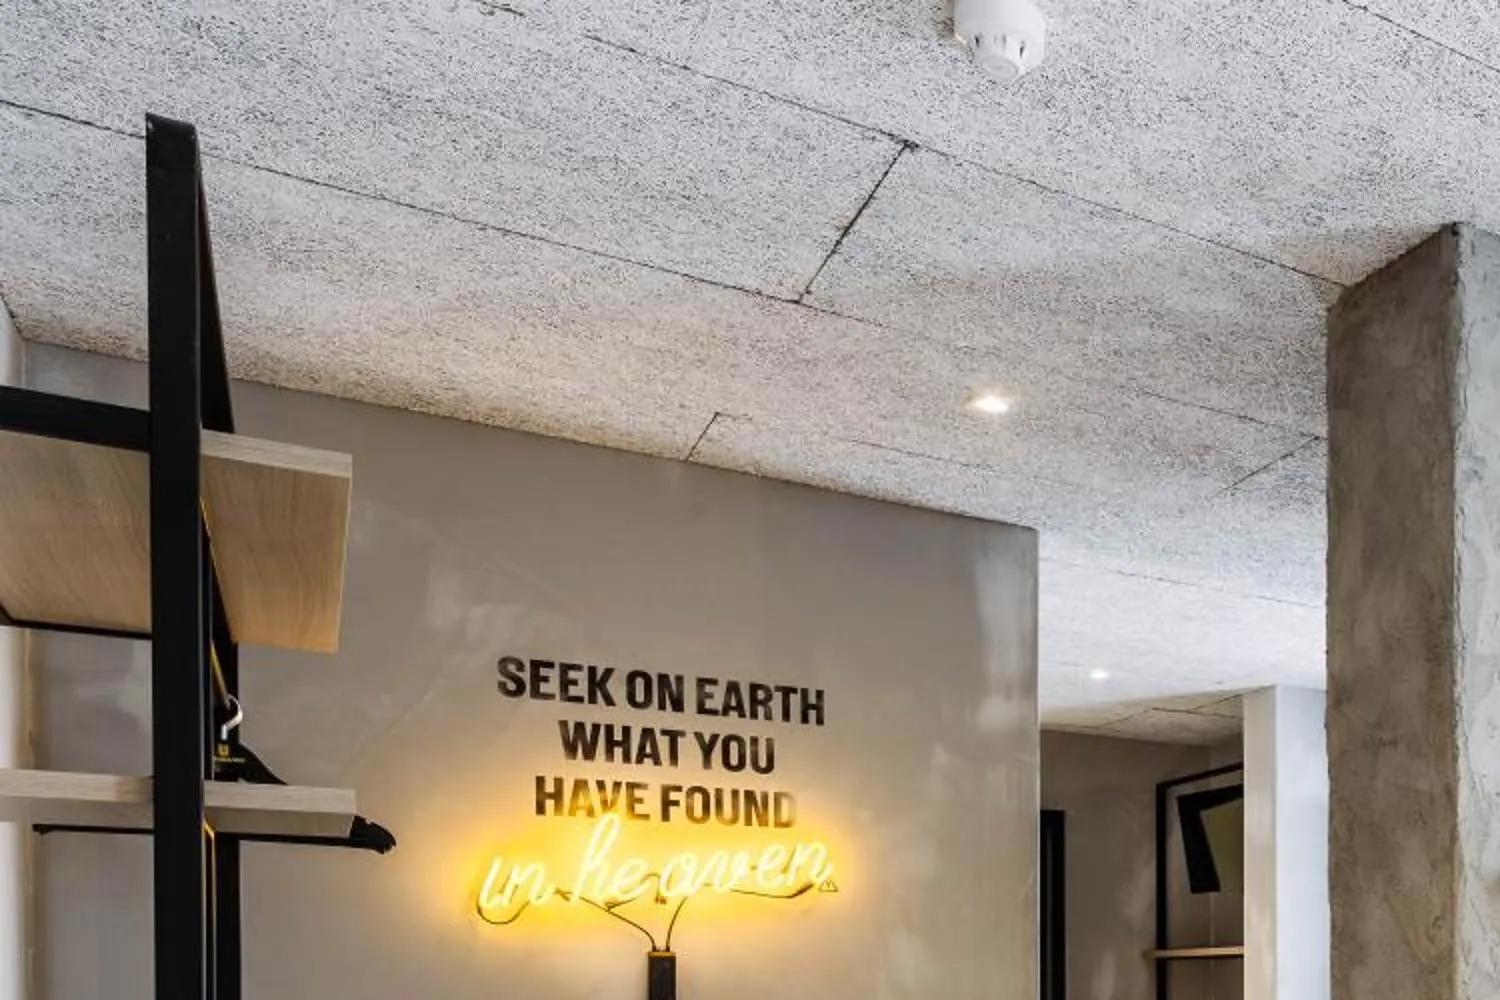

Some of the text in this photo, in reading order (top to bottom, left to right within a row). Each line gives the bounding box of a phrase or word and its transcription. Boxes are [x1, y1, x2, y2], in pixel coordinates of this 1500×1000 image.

[497, 656, 825, 726] SEEK ON EARTH
[558, 720, 775, 774] WHAT YOU
[535, 775, 797, 829] HAVE FOUND
[479, 812, 833, 909] in heaven
